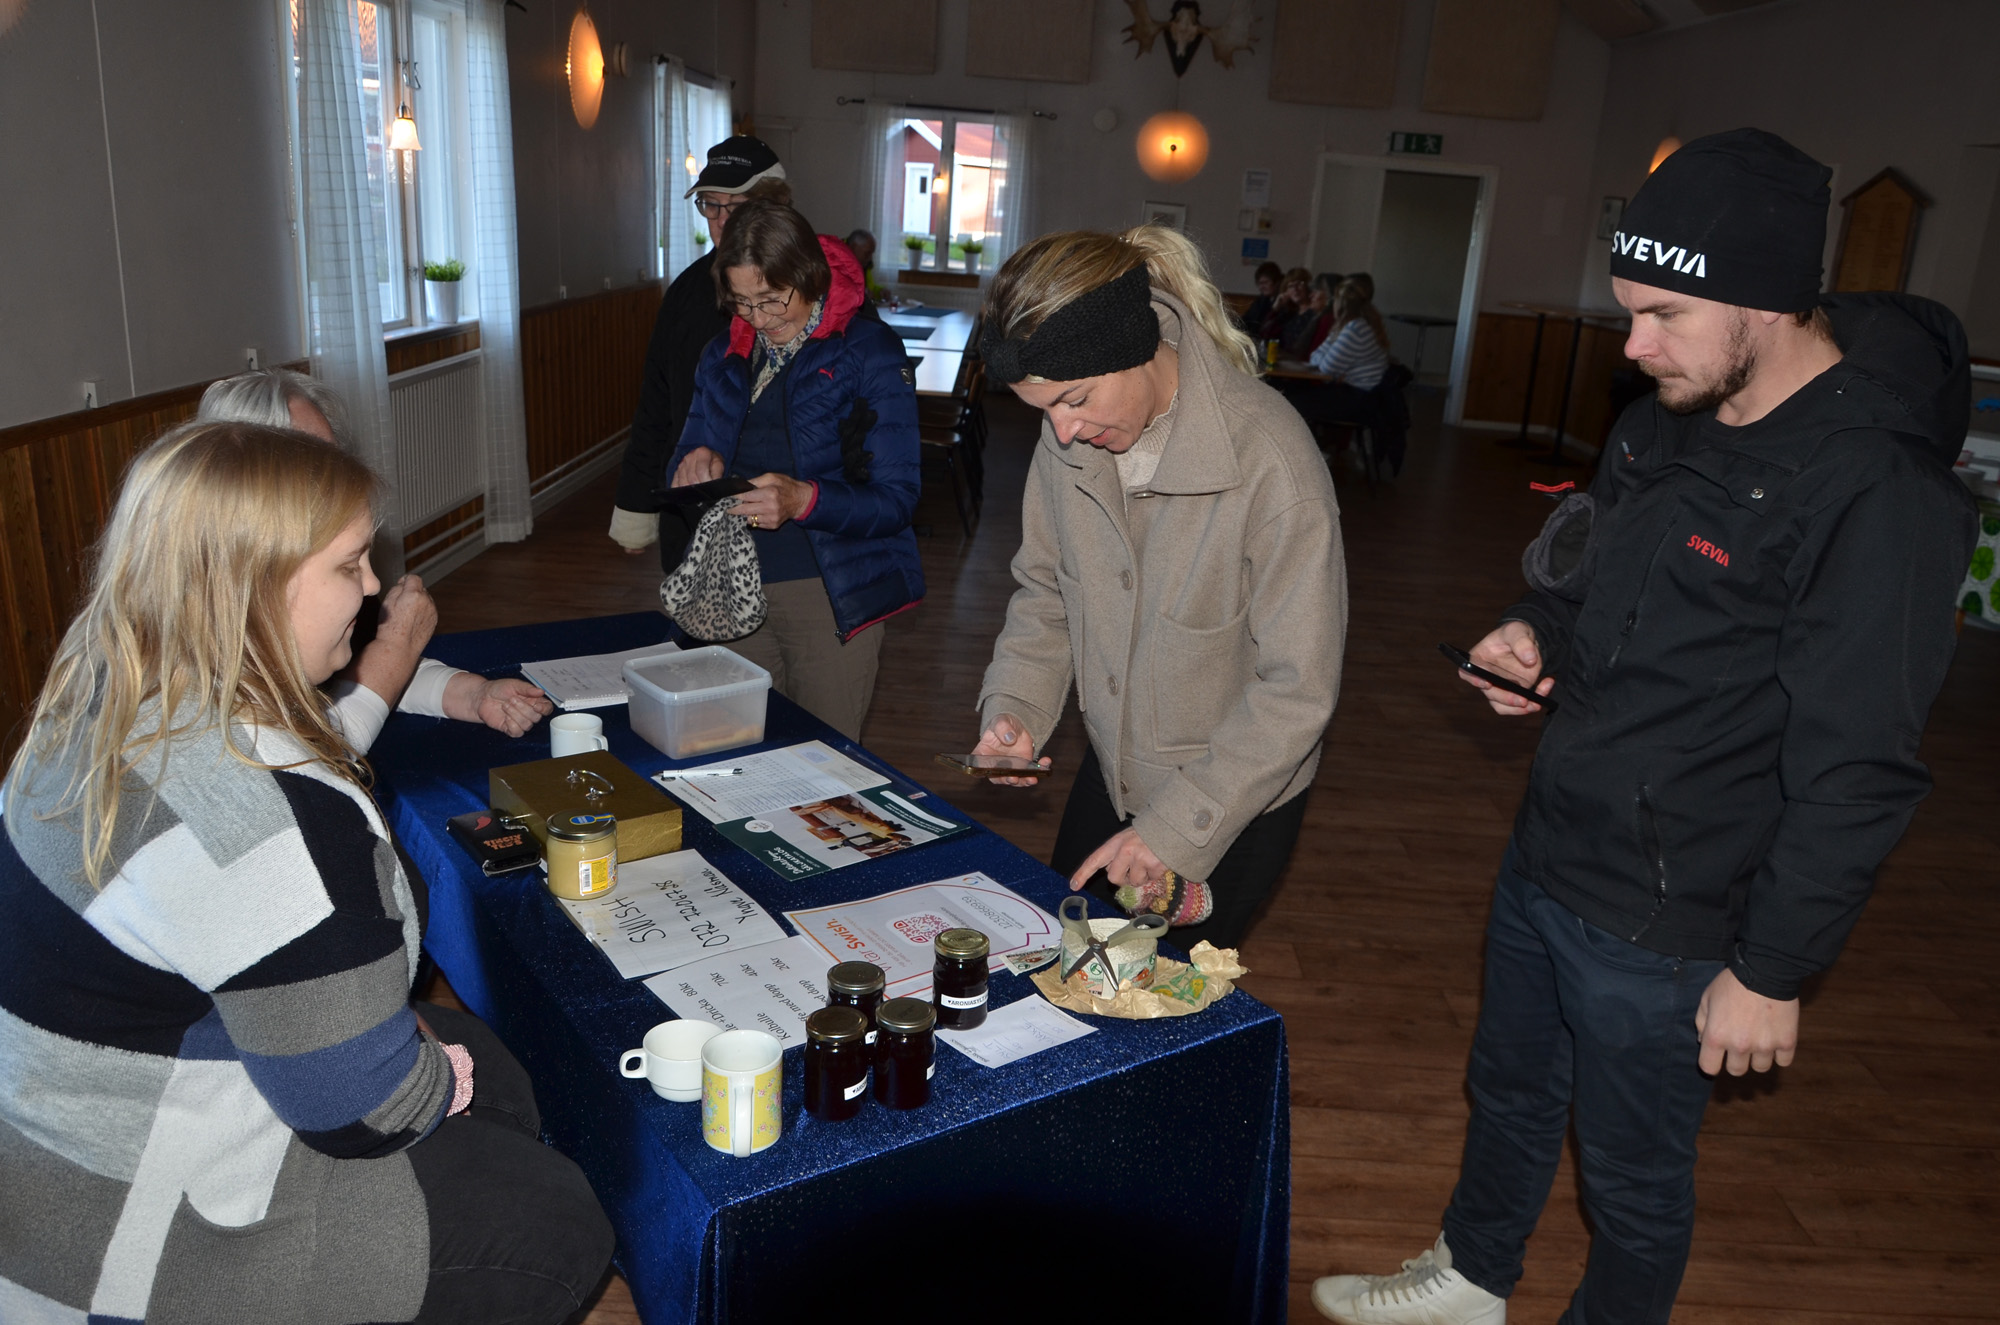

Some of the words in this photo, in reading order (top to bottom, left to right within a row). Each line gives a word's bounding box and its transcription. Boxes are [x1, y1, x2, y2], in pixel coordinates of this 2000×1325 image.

[1612, 230, 1706, 278] SVEVIA
[1686, 535, 1730, 566] SVEVIA
[730, 896, 759, 924] Yngve
[601, 896, 667, 944] SWISH
[690, 920, 730, 948] 072
[826, 918, 866, 950] Swish.
[770, 956, 790, 971] 20kr
[859, 950, 880, 964] tar
[710, 972, 731, 987] 70kr
[740, 963, 758, 978] 40kr
[678, 982, 698, 998] 80kr
[764, 983, 784, 1000] dopp
[798, 978, 820, 996] dopp
[783, 996, 802, 1012] med
[756, 1012, 792, 1041] Kolbulle
